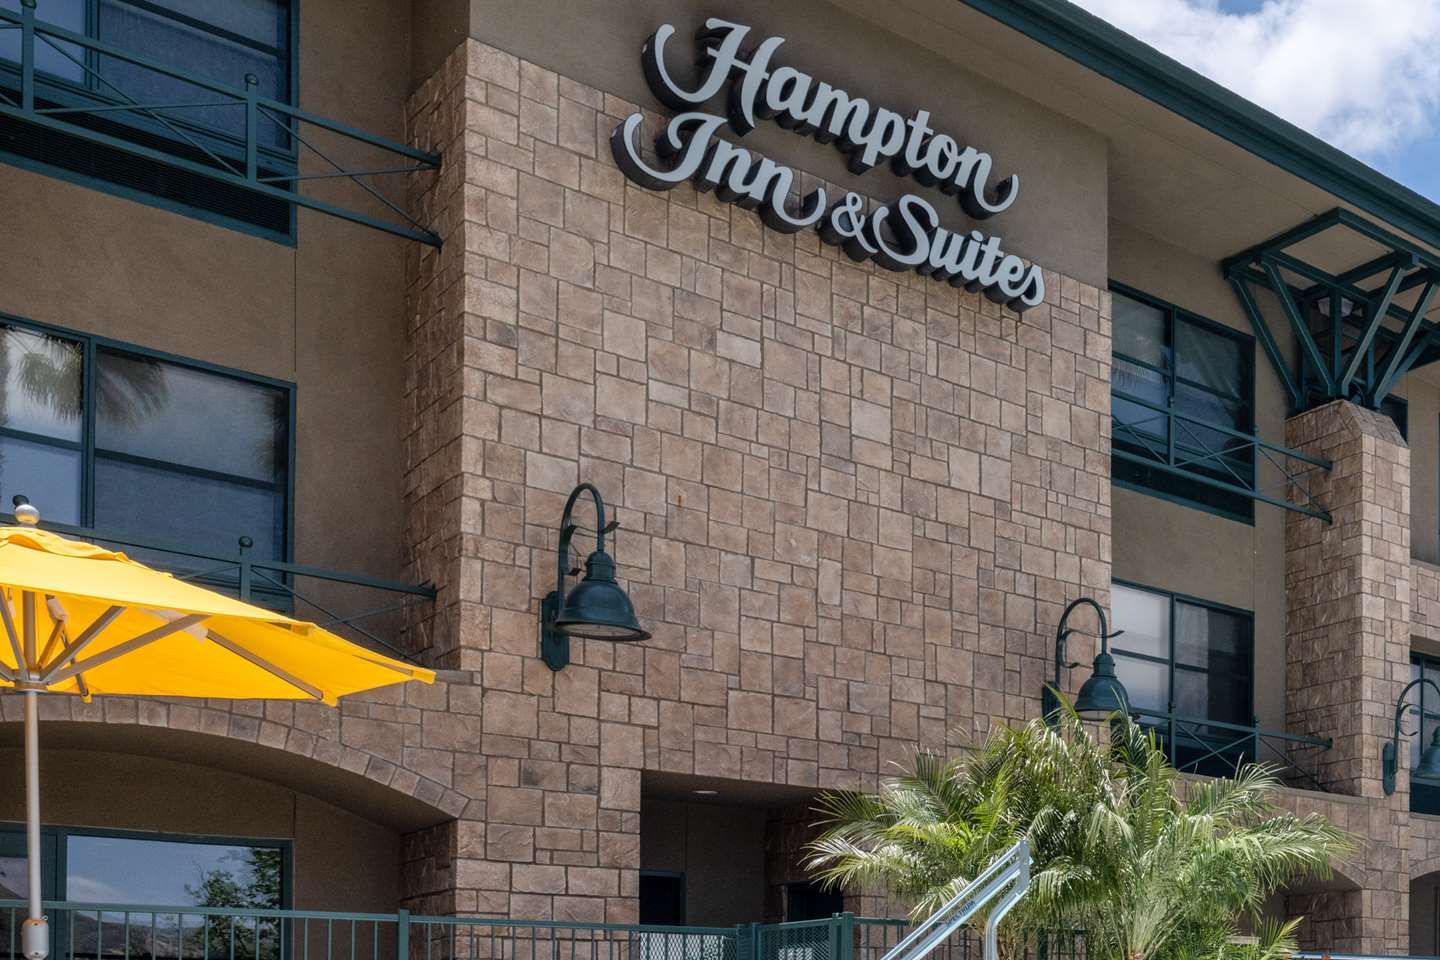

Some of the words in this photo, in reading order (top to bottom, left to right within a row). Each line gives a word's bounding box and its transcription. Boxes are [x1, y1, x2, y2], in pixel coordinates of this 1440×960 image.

[620, 110, 828, 228] Inn
[872, 192, 1047, 308] Suites
[650, 16, 1020, 214] Hampton
